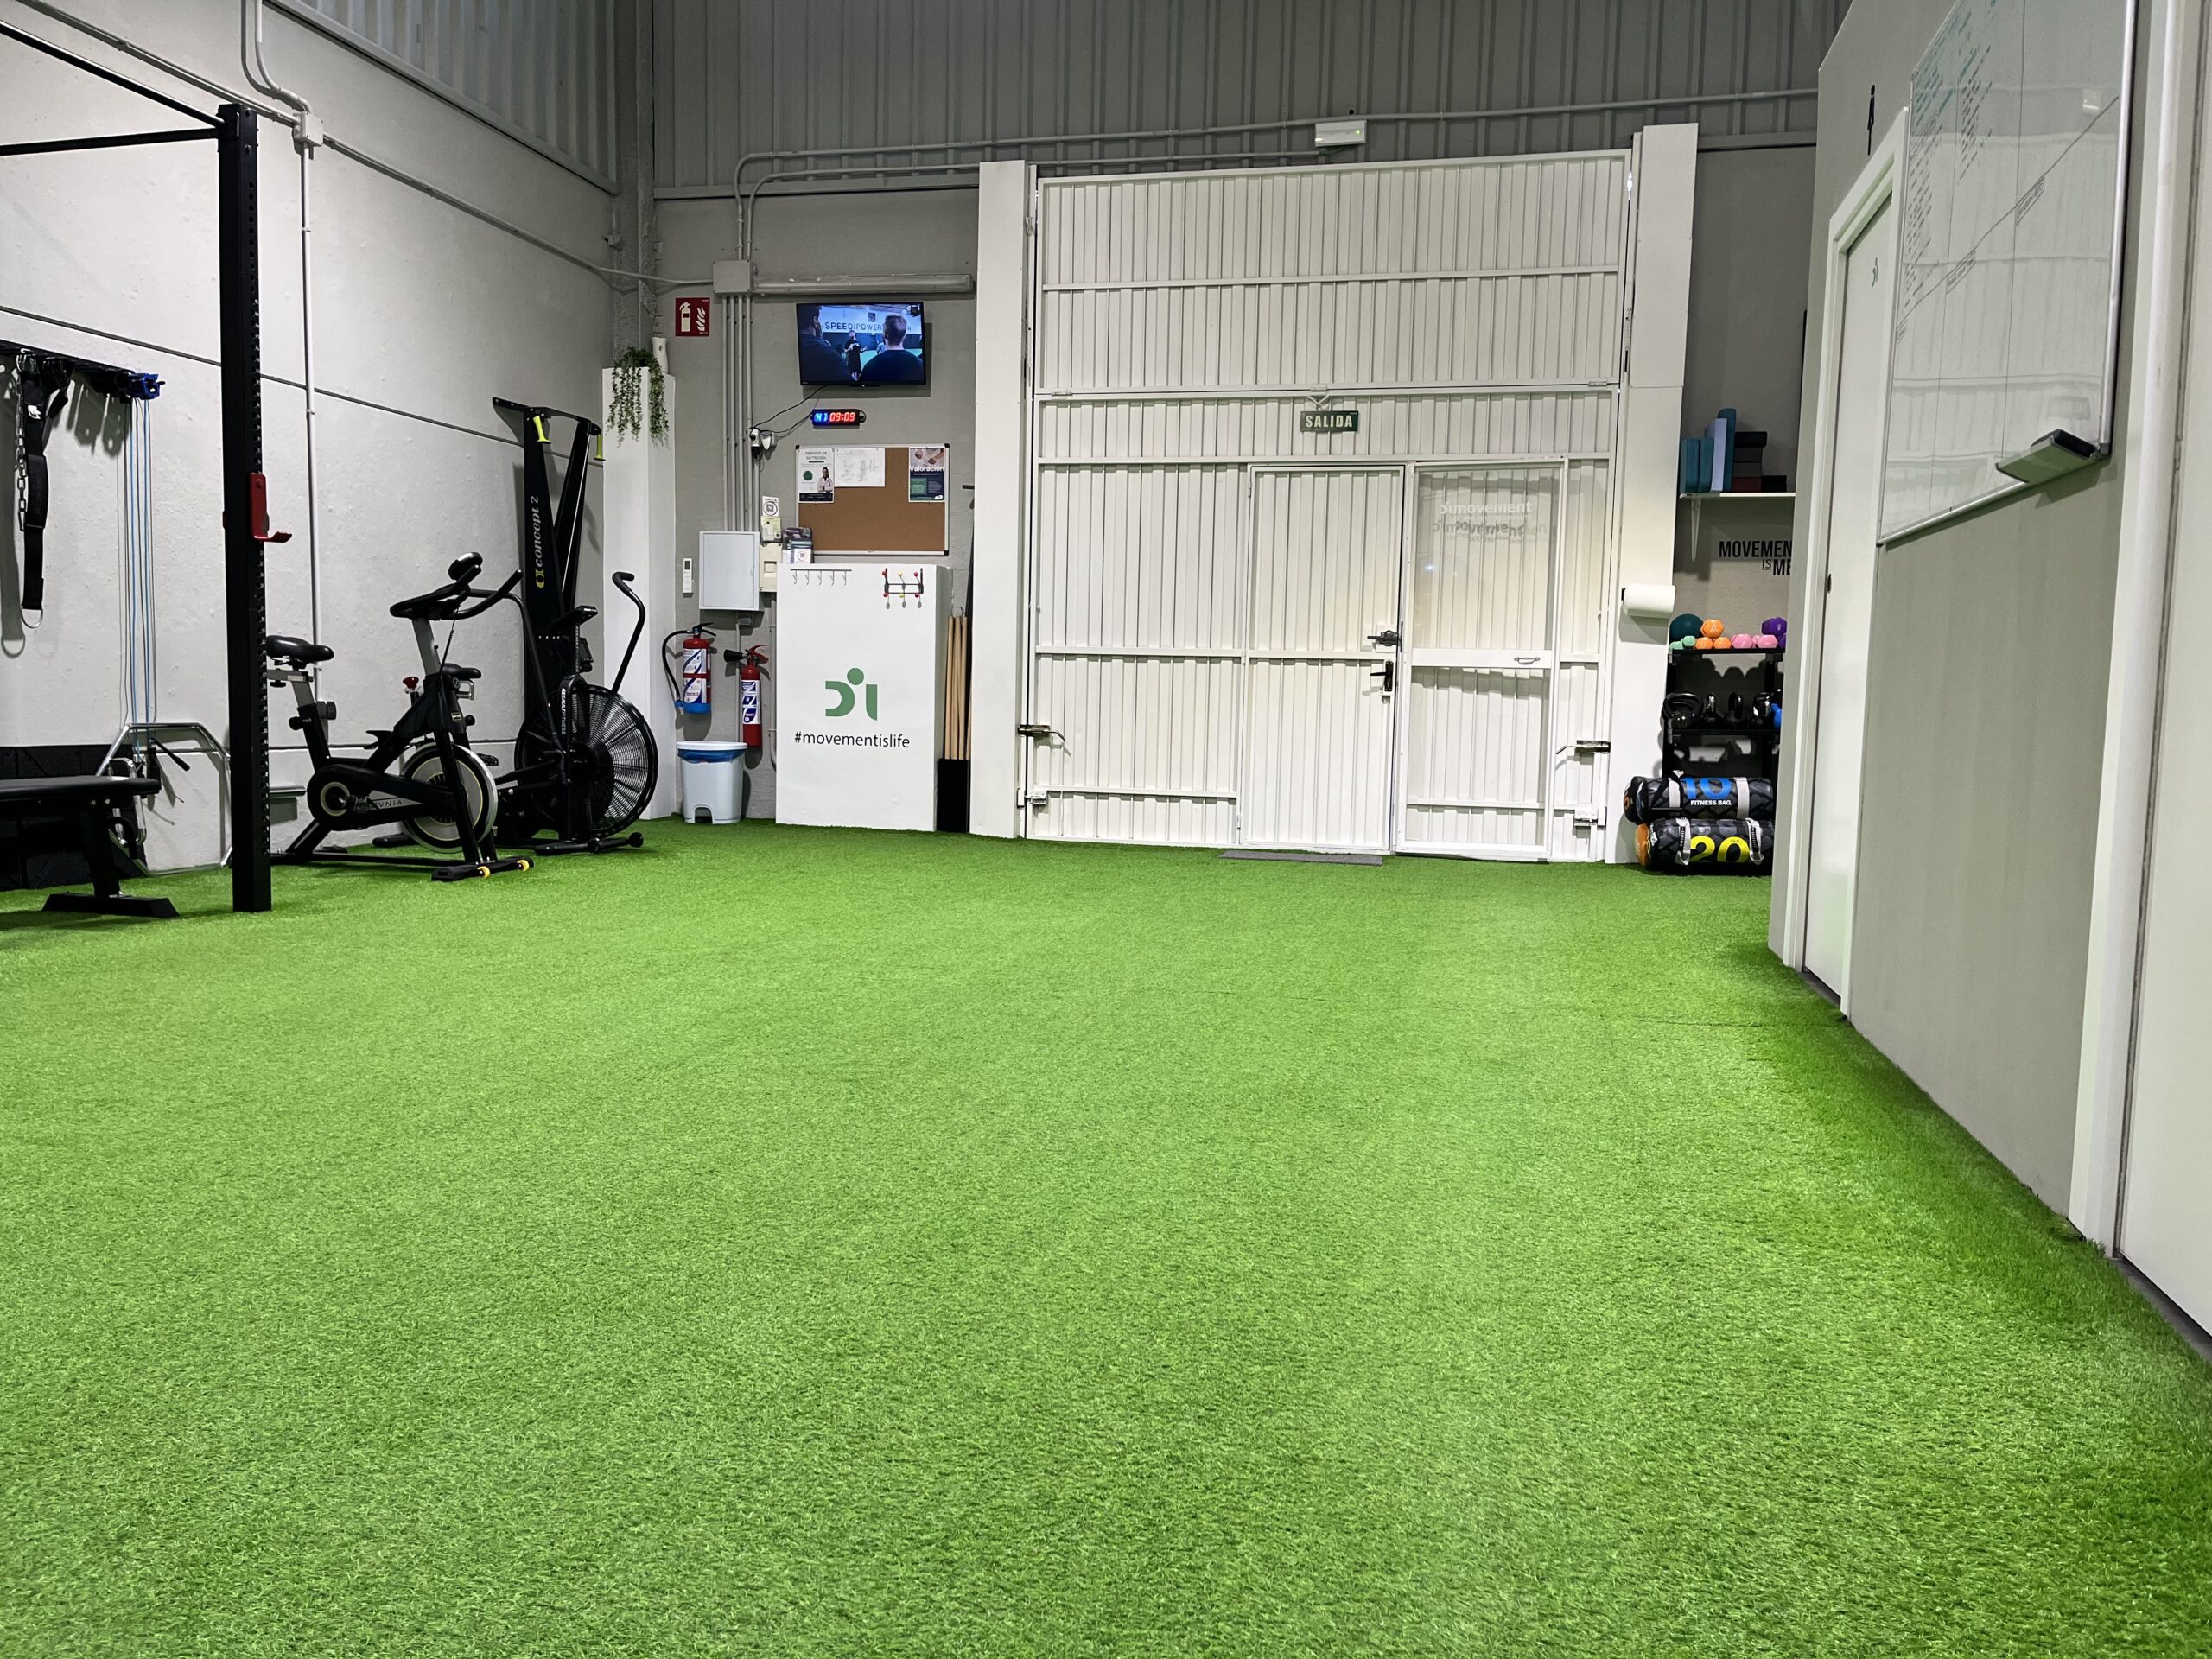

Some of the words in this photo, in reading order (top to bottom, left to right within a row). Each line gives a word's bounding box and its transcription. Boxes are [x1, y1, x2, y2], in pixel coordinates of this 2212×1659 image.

[824, 321, 853, 330] SPEED
[830, 411, 855, 422] 09:09
[1306, 415, 1353, 428] SALIDA
[530, 495, 539, 505] 2
[531, 507, 543, 568] concept
[795, 731, 910, 748] #movementislife
[1681, 777, 1732, 799] 10
[1690, 835, 1751, 863] 20
